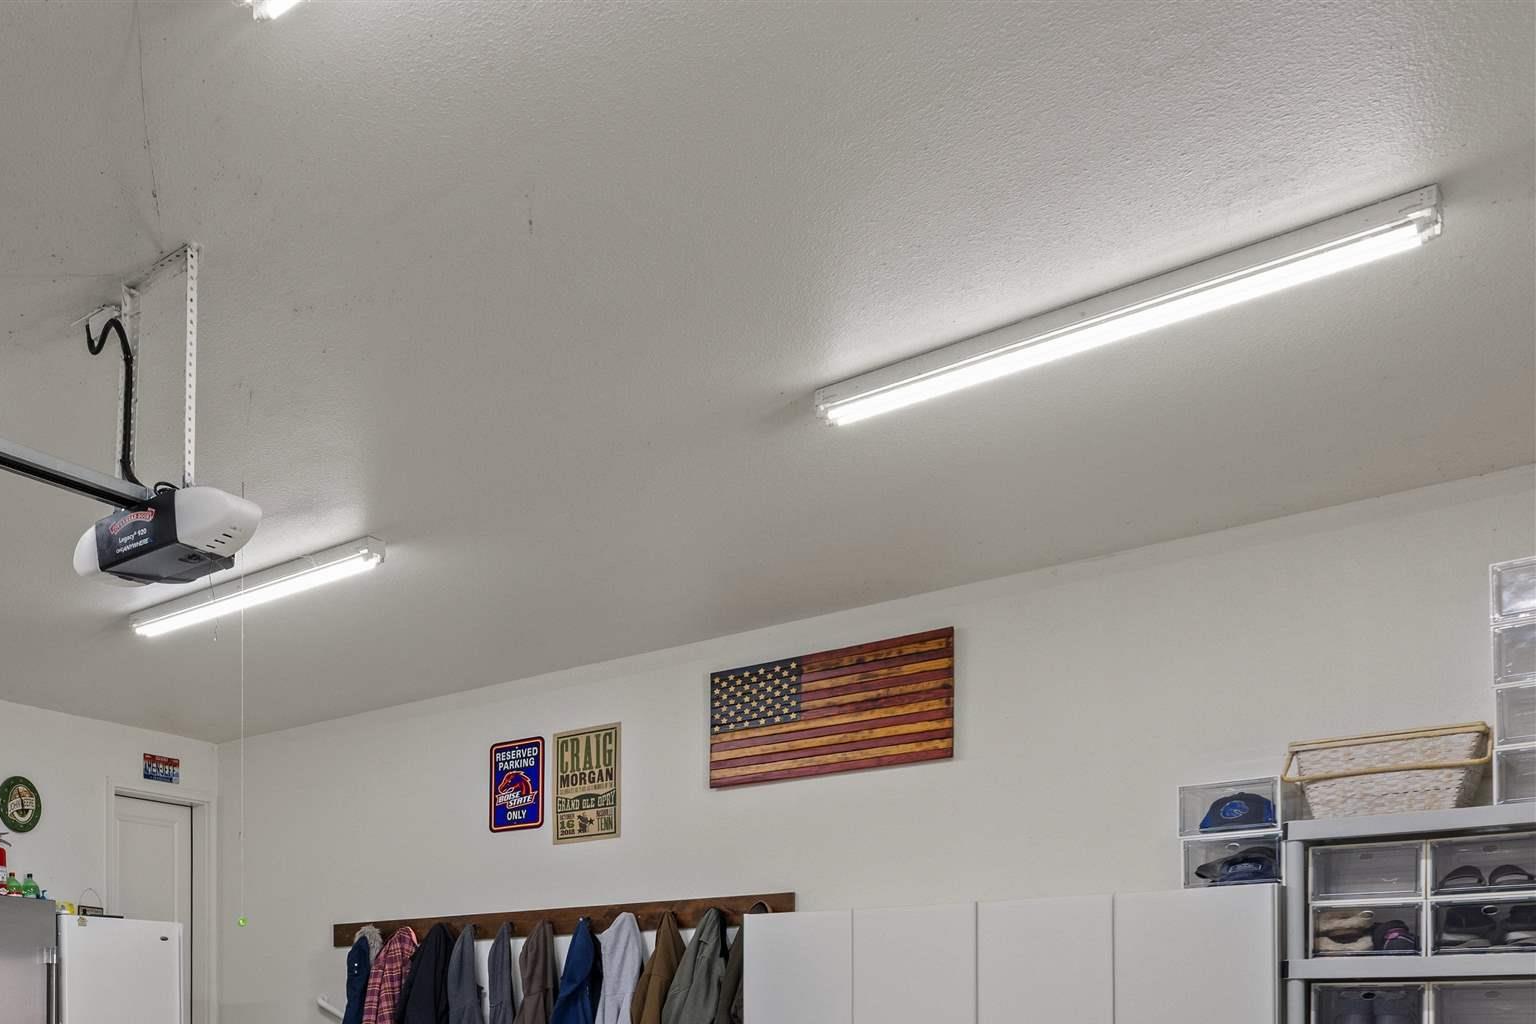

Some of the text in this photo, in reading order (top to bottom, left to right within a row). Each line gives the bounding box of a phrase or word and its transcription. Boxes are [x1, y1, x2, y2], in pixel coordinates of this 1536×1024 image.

[496, 747, 538, 762] RESERVED
[560, 732, 613, 773] CRAIG
[498, 757, 535, 771] PARKING
[560, 767, 613, 788] MORGAN
[499, 790, 521, 803] BOISE
[509, 794, 533, 807] STATE
[557, 790, 616, 813] GRAND OLE OPRY
[507, 809, 527, 821] ONLY
